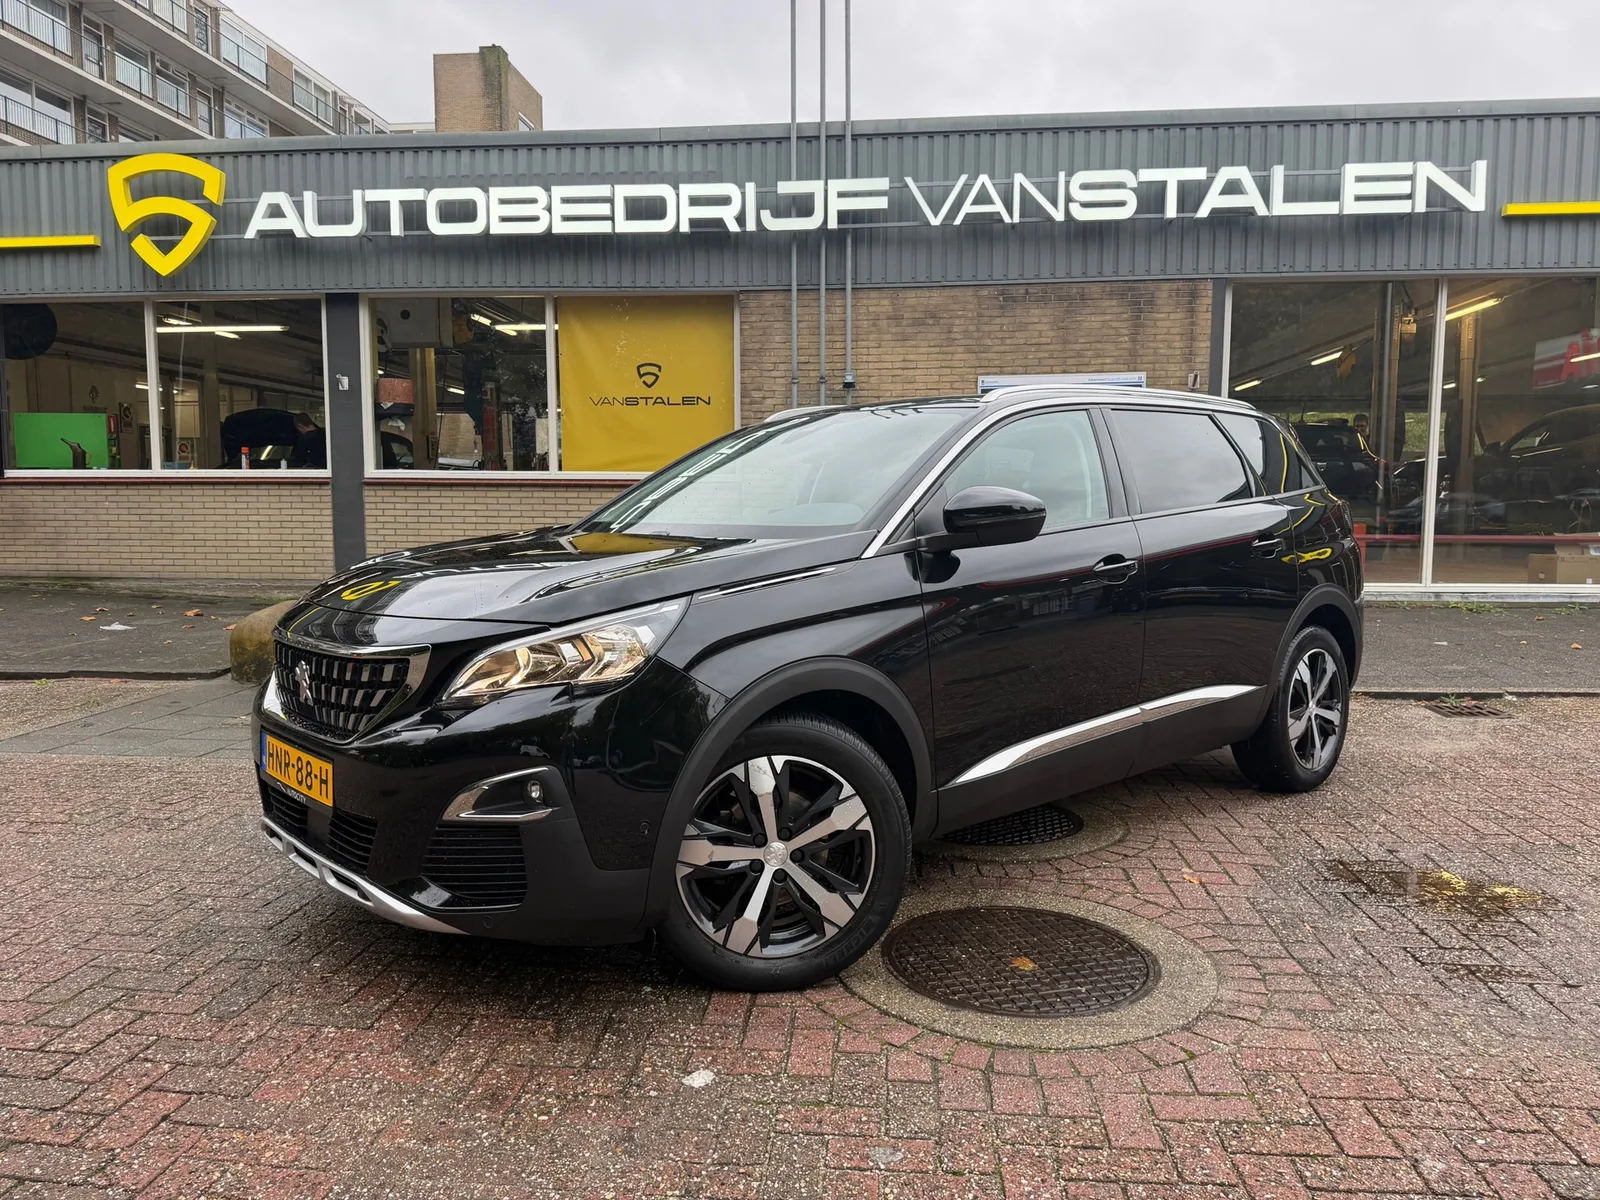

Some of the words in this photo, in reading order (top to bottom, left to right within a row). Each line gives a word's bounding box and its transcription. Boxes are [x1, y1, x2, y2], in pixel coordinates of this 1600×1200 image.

[244, 177, 890, 239] AUTOBEDRIJF
[904, 160, 1488, 226] VANSTALEN
[589, 396, 711, 406] VANSTALEN
[267, 740, 329, 800] HNR-88-H
[286, 787, 307, 804] AUTOCITY
